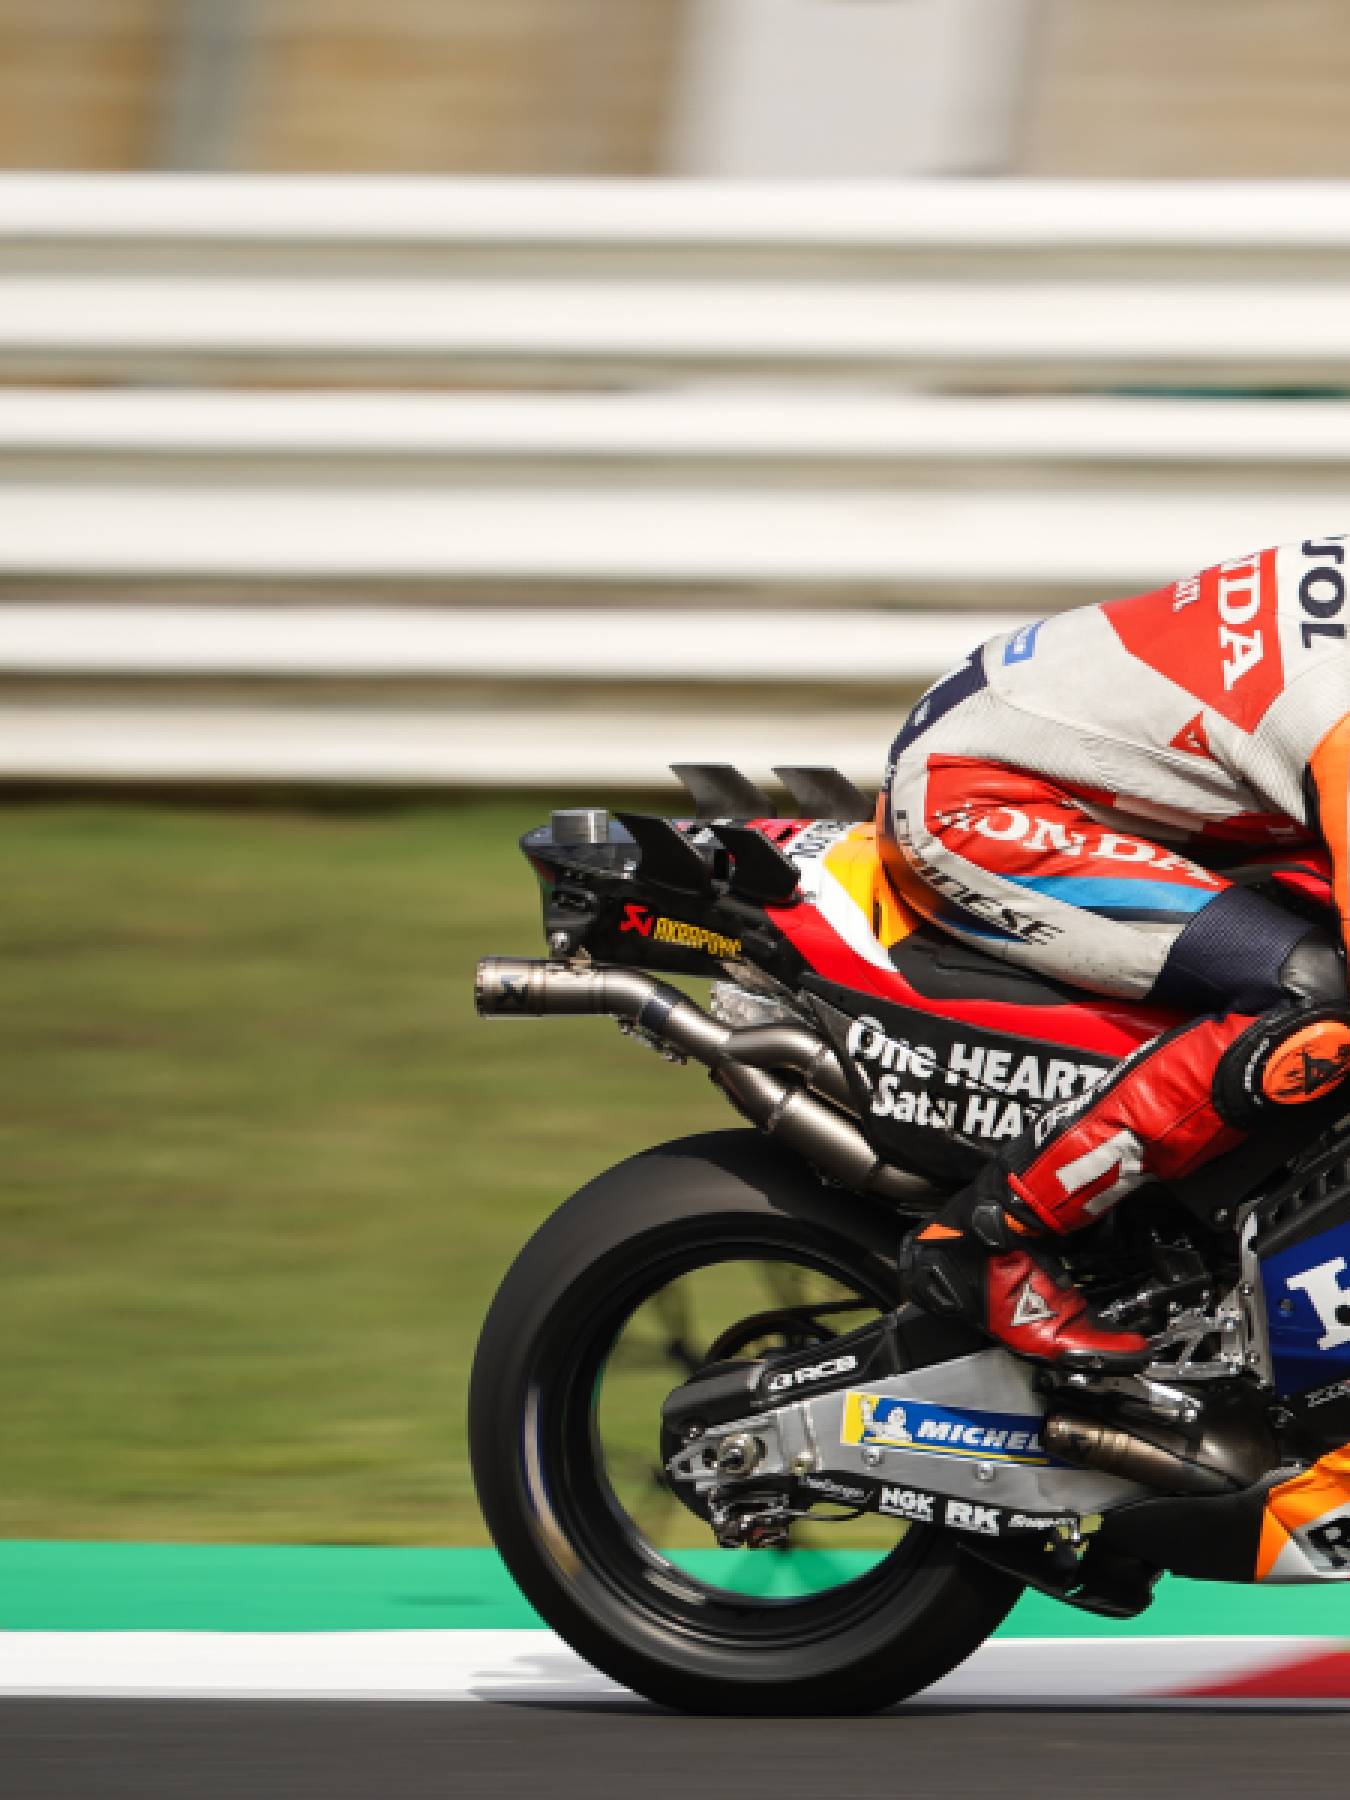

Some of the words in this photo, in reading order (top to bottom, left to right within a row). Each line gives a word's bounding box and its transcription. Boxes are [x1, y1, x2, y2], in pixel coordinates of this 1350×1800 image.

[1299, 538, 1348, 649] SOL
[846, 1015, 938, 1079] One
[944, 1041, 1110, 1102] HEART
[869, 1073, 958, 1129] Satu
[916, 1420, 1044, 1453] MICHEL
[879, 1485, 935, 1514] NGK
[945, 1500, 1002, 1530] RK
